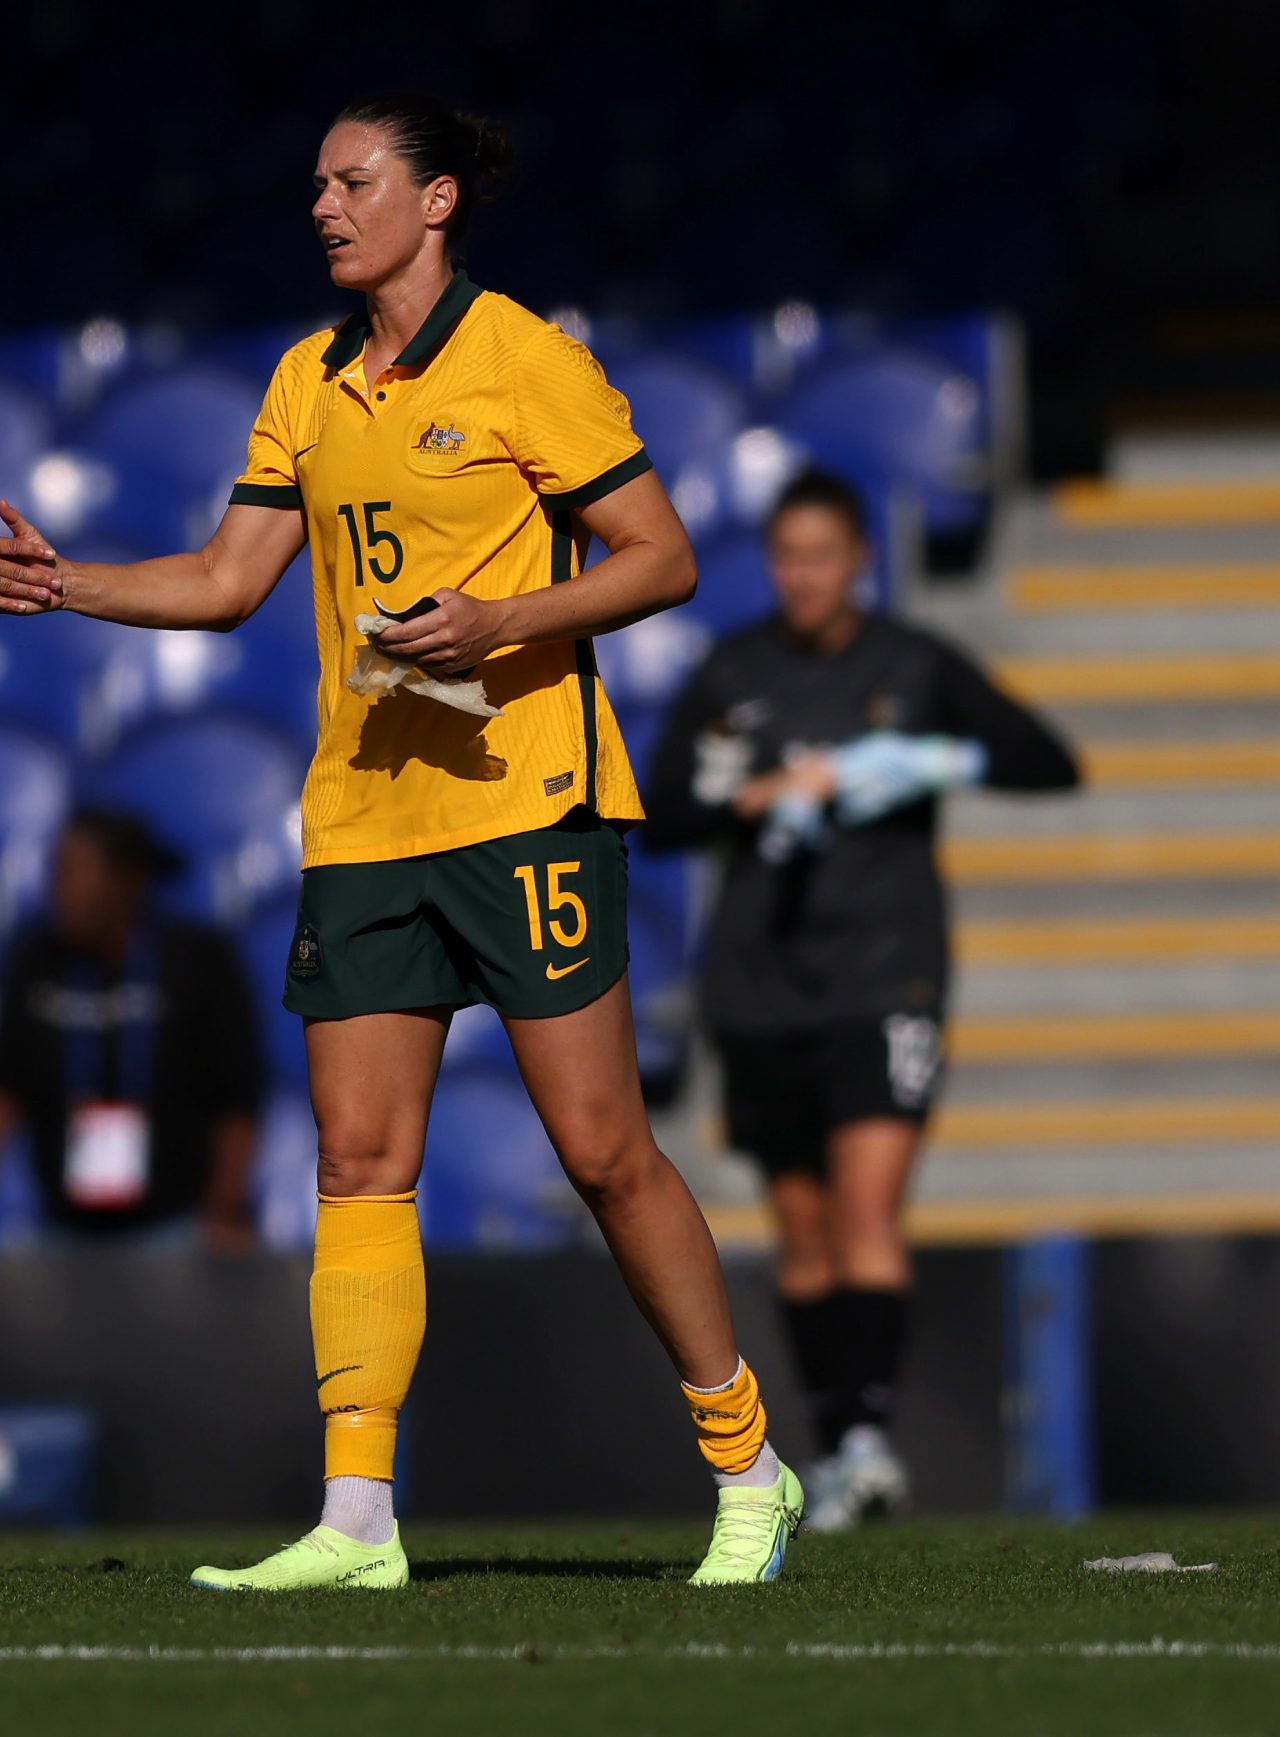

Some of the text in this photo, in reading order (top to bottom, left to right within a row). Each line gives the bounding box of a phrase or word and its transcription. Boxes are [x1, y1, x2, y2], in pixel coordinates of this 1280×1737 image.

[337, 500, 404, 587] 15
[513, 860, 588, 951] 15
[335, 1559, 386, 1583] ULTRA
